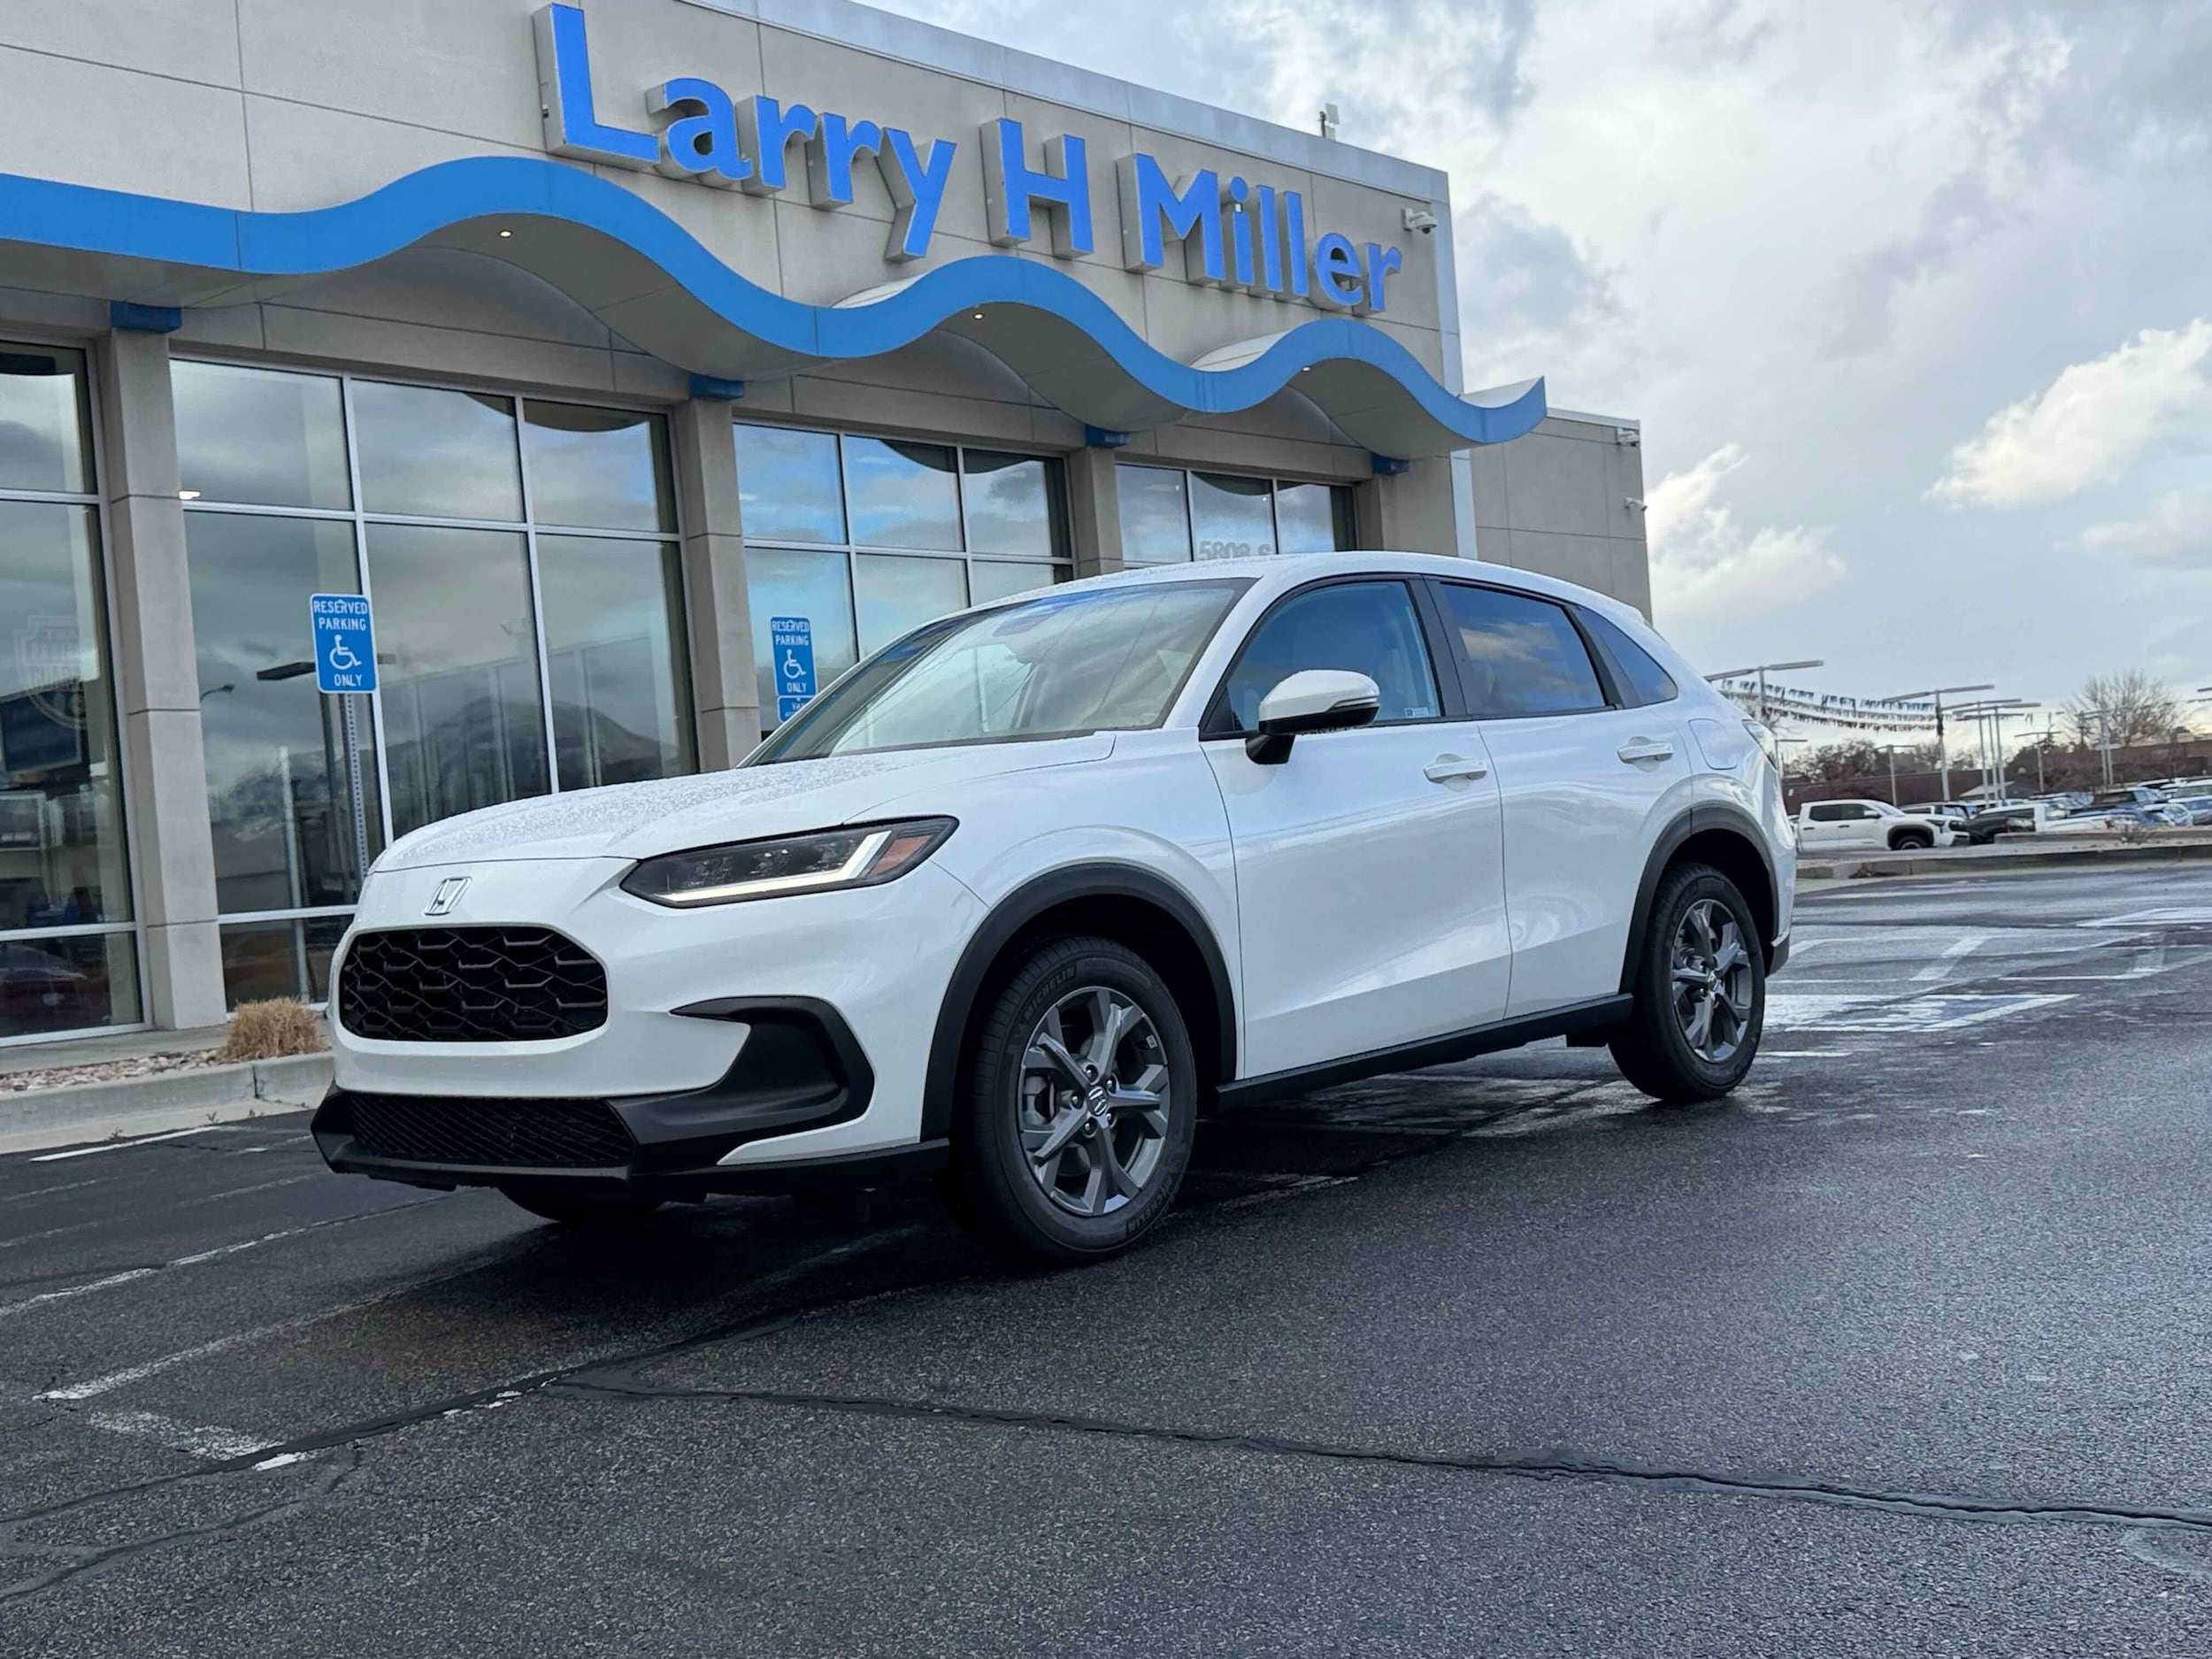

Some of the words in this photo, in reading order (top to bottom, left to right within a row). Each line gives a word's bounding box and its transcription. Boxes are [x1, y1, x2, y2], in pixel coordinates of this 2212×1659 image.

[534, 3, 956, 264] Larry
[980, 118, 1094, 259] H
[1118, 153, 1402, 317] Miller
[313, 599, 368, 615] RESERVED
[319, 618, 366, 631] PARKING
[772, 619, 810, 633] RESERVED
[775, 634, 809, 647] PARKING
[334, 673, 362, 687] ONLY
[786, 681, 807, 694] ONLY
